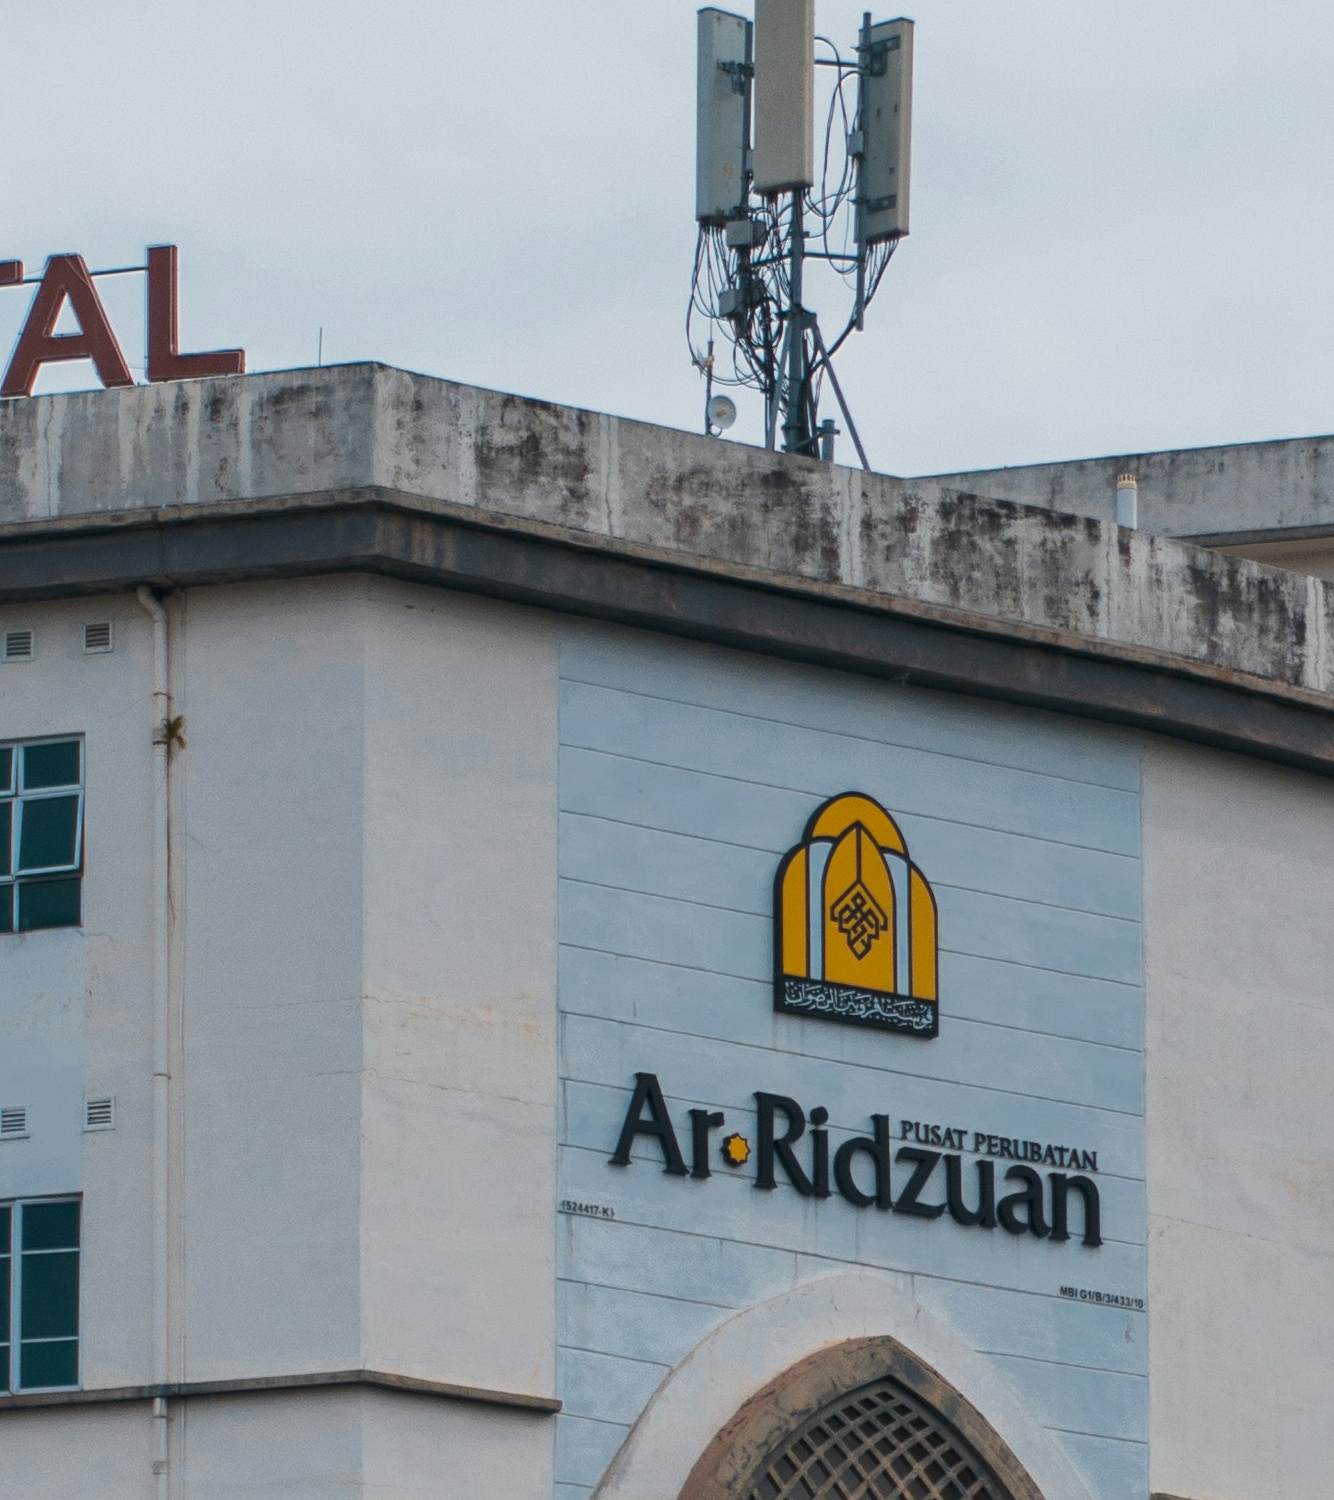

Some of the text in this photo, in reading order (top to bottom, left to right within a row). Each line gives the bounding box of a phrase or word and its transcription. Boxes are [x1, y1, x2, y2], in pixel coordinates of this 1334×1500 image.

[899, 1119, 1098, 1172] PUSAT PERUBATAN
[1059, 1285, 1078, 1298] MBI
